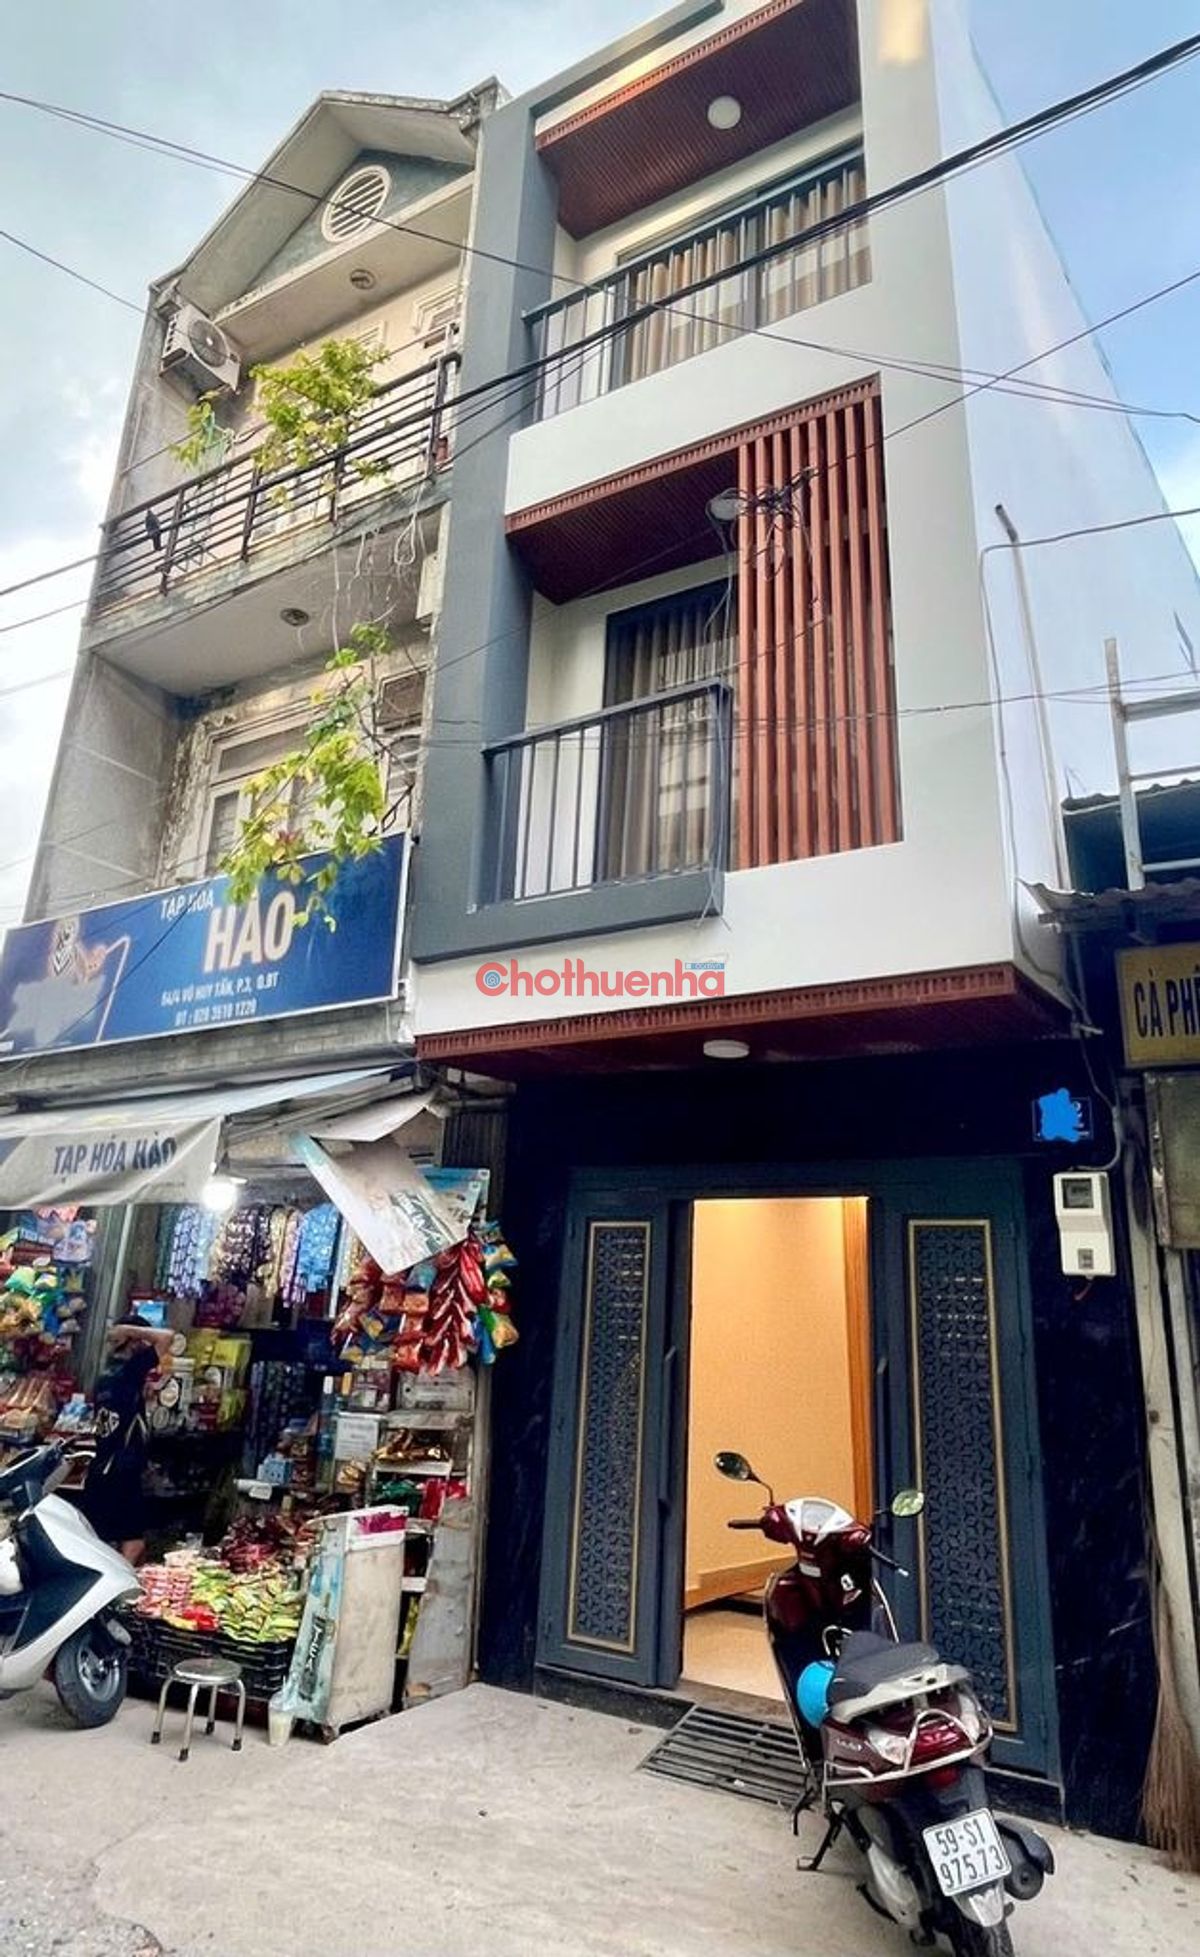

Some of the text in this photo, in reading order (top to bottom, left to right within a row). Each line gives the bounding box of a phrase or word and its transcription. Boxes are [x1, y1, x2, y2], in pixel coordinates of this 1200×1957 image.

[1133, 966, 1163, 1038] CÀ
[54, 1144, 87, 1184] TẠP
[89, 1134, 126, 1172] HÓA
